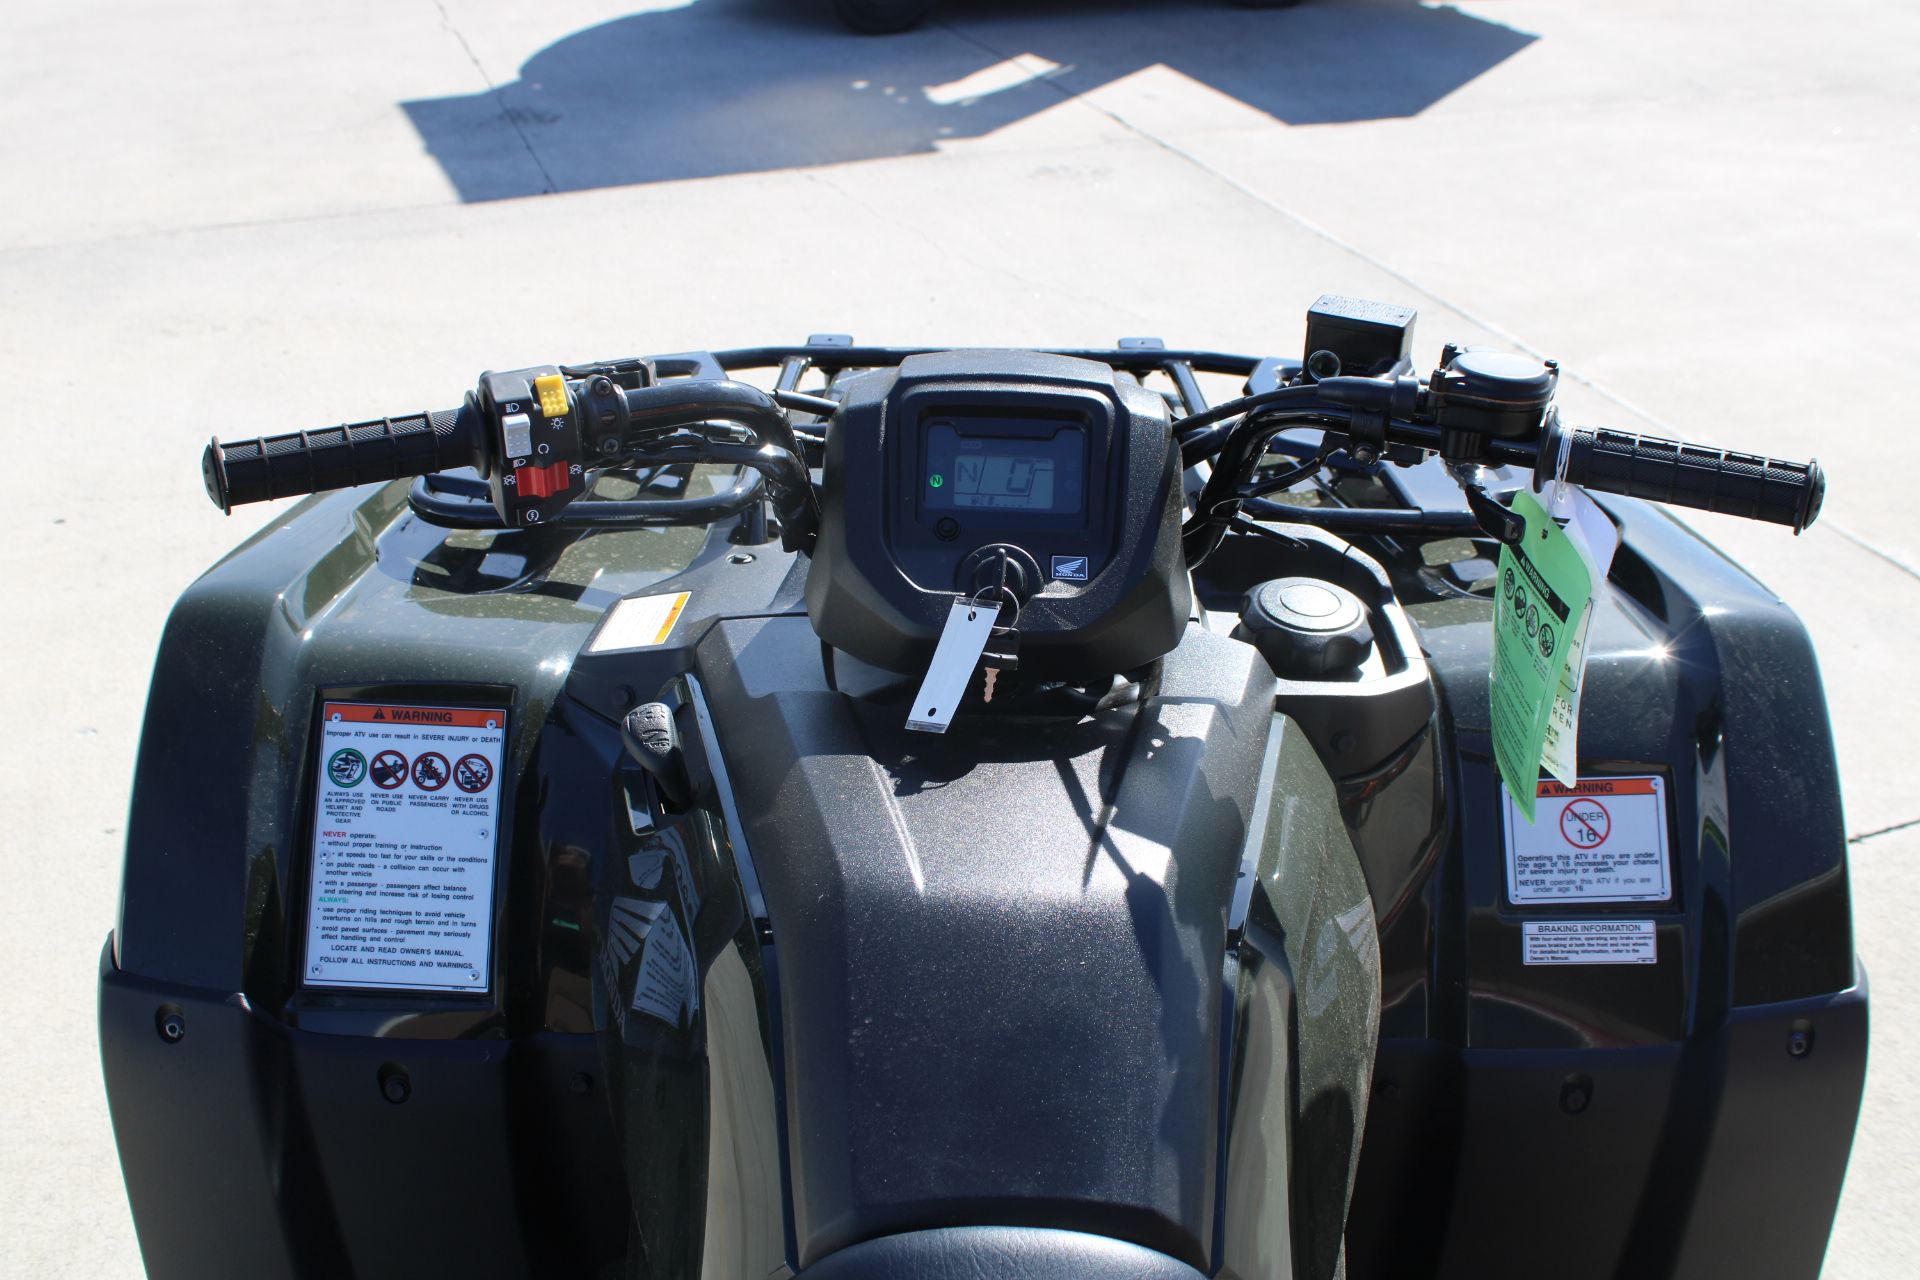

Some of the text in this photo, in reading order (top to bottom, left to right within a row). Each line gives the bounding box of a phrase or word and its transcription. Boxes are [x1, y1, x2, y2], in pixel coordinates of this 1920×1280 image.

[957, 462, 978, 482] N
[932, 476, 940, 485] N
[1525, 560, 1550, 599] WARNING
[1555, 694, 1573, 716] FOR
[392, 710, 452, 722] WARNING
[1554, 783, 1613, 793] WARNING
[1566, 811, 1604, 822] UNDER
[1577, 828, 1596, 843] 16
[1518, 854, 1553, 863] Operating
[367, 958, 416, 966] INSTRUCTIONS
